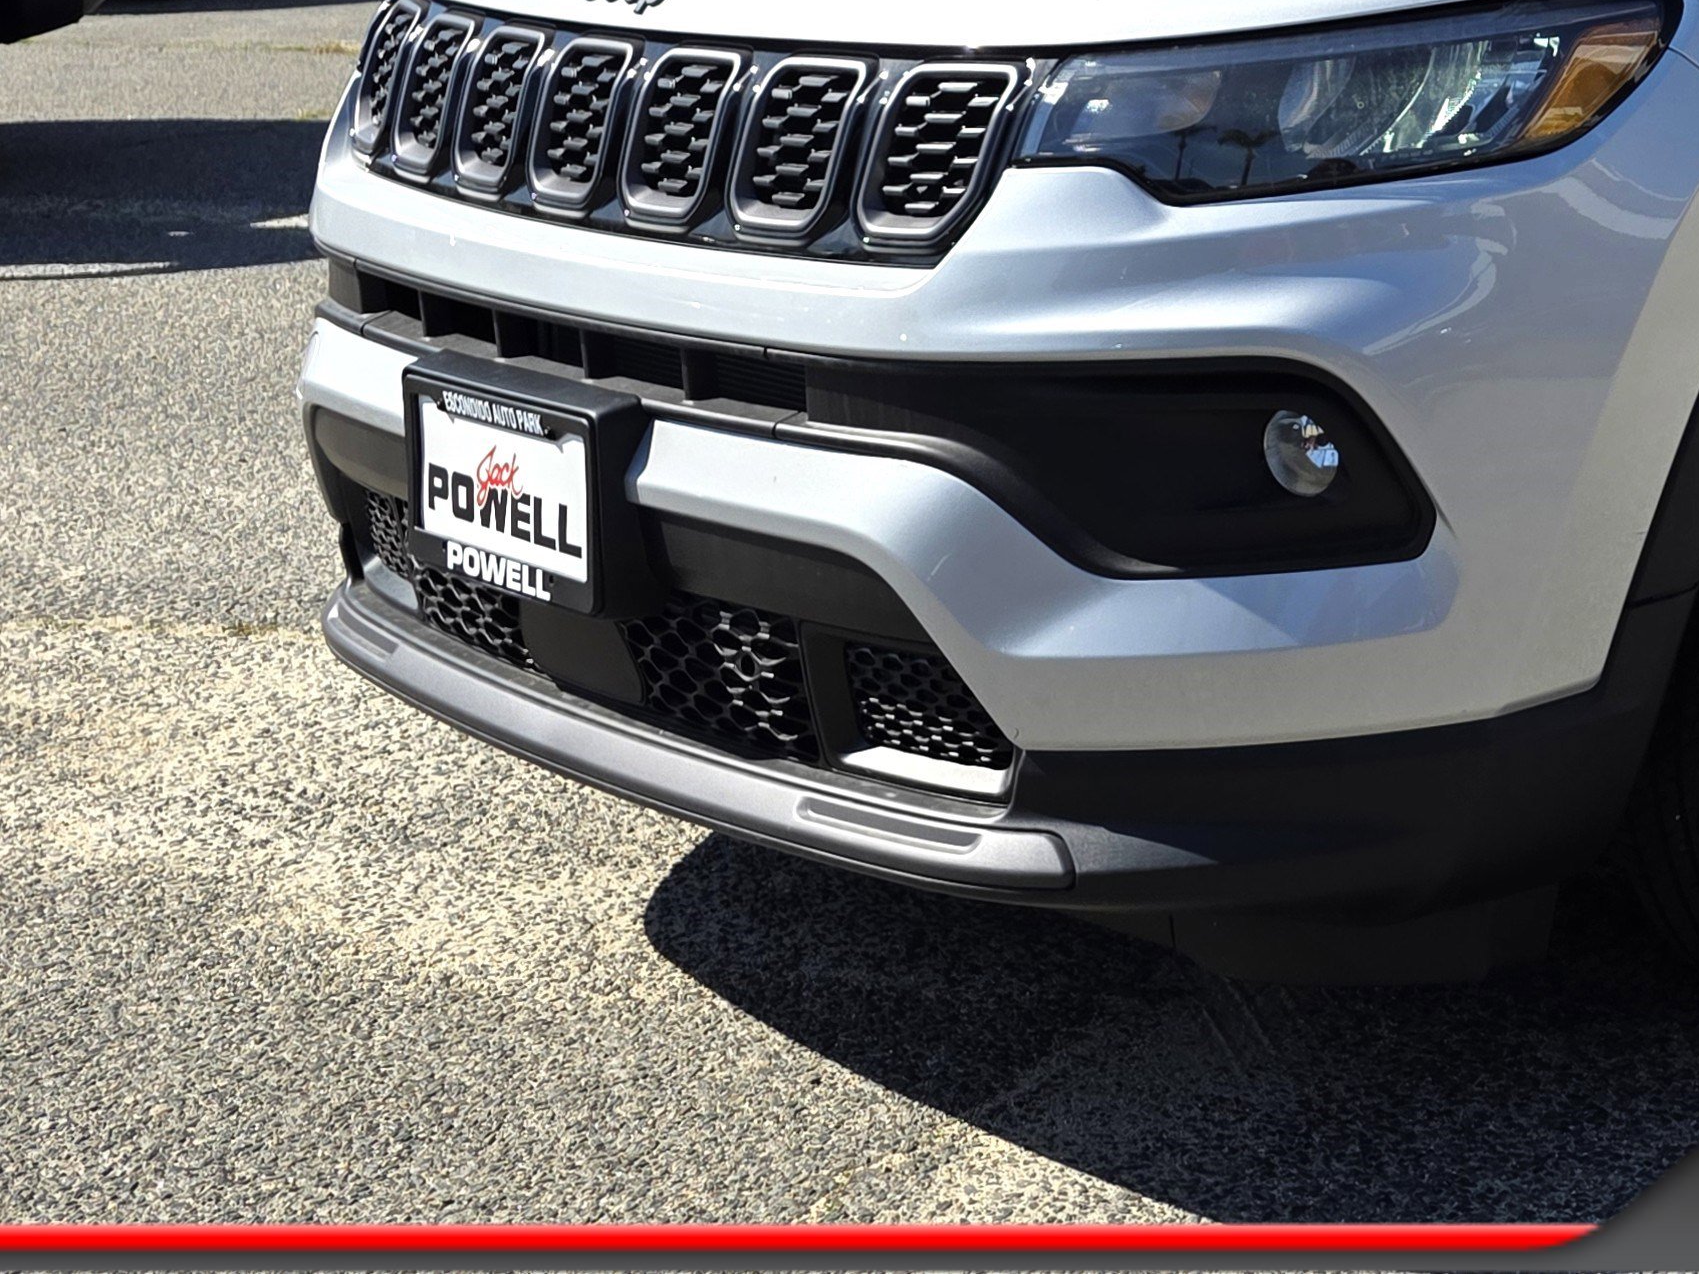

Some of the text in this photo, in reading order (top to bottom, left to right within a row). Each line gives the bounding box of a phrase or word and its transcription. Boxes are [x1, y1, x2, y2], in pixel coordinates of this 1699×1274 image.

[442, 391, 544, 436] ESCONDIDO AUTO PARK
[476, 444, 524, 508] Jack
[428, 462, 583, 560] POWELL
[446, 540, 551, 602] POWELL
